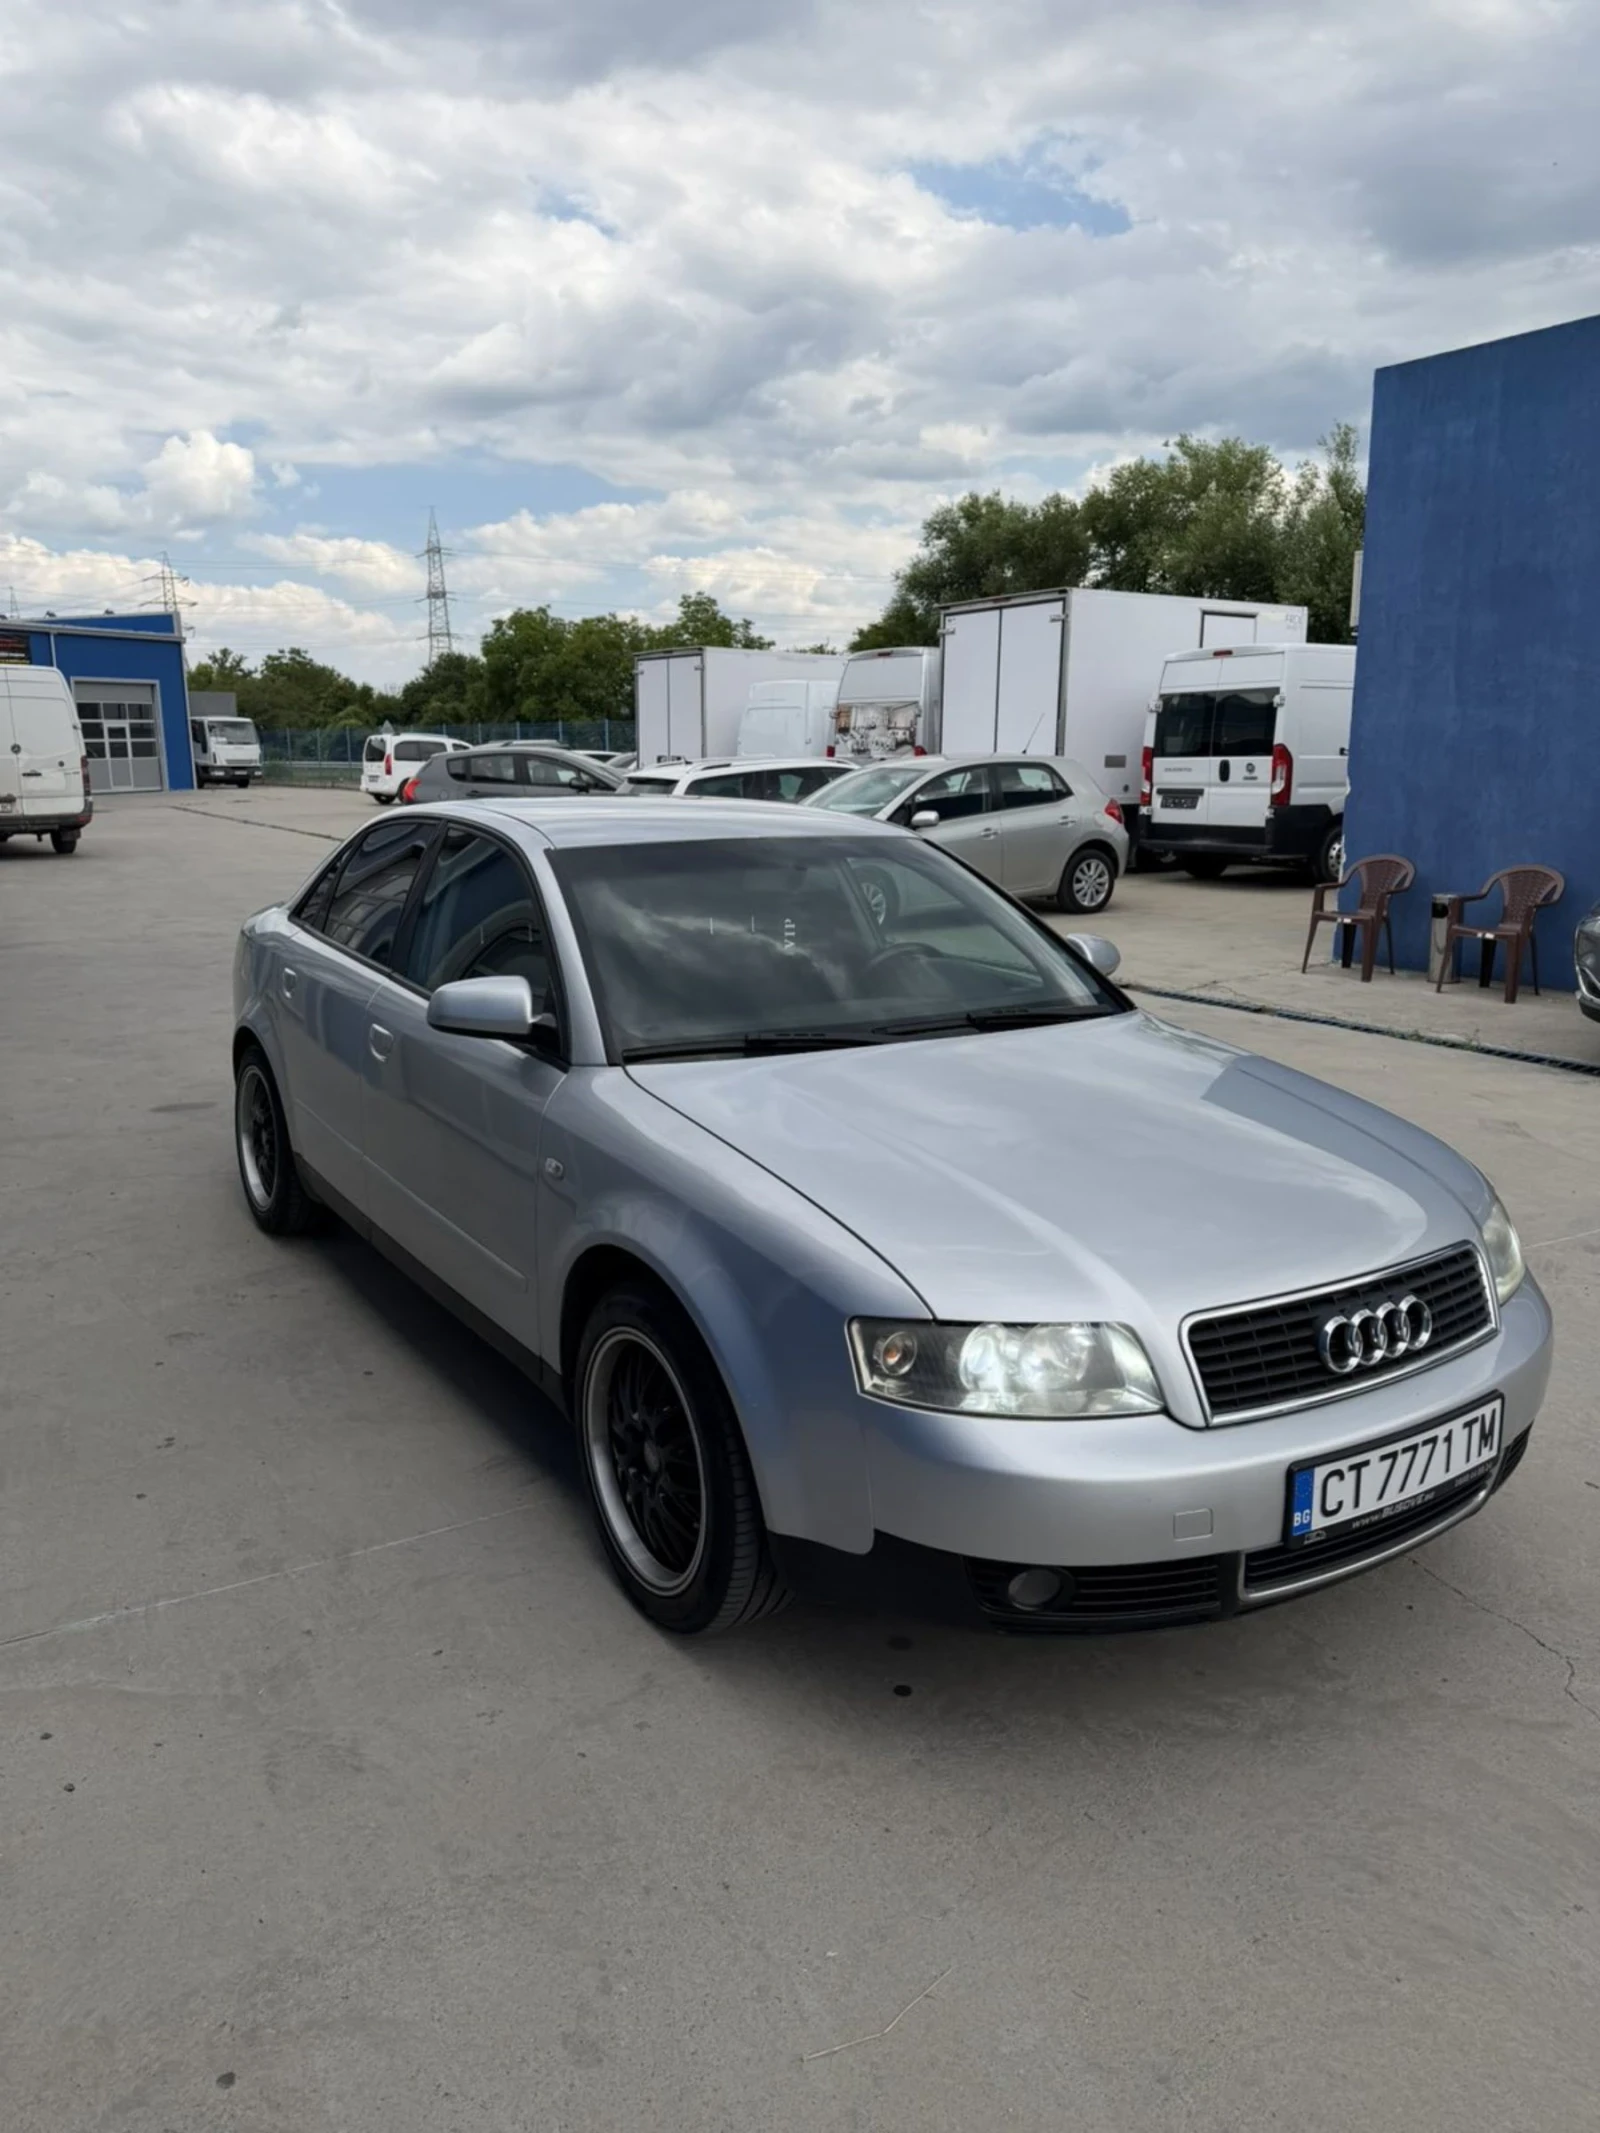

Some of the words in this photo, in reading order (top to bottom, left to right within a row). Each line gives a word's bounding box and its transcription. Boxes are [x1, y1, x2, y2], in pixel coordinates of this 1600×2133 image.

[784, 917, 796, 950] VIP
[1320, 1459, 1371, 1518] CT
[1376, 1429, 1453, 1502] 7771
[1462, 1407, 1497, 1464] TM
[1293, 1508, 1311, 1527] BG
